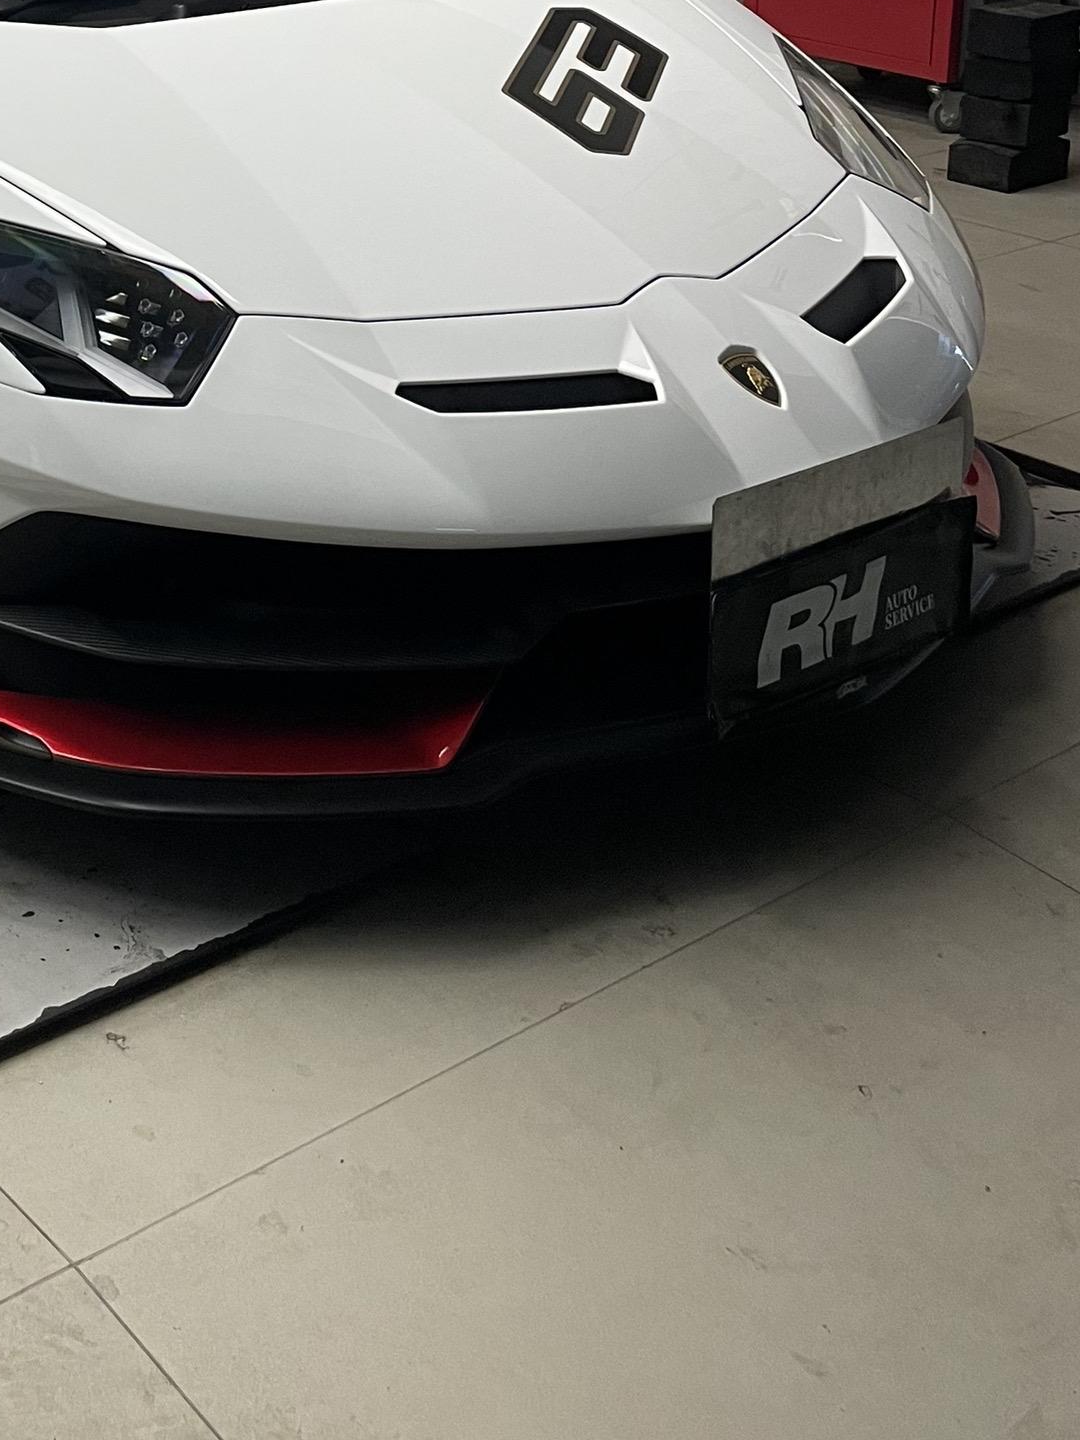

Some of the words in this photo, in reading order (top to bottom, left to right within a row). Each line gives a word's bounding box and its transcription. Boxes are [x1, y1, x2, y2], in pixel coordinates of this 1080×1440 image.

[501, 7, 669, 156] 63
[757, 555, 887, 689] RH
[884, 593, 936, 630] SERVICE
[886, 584, 918, 611] AUTO
